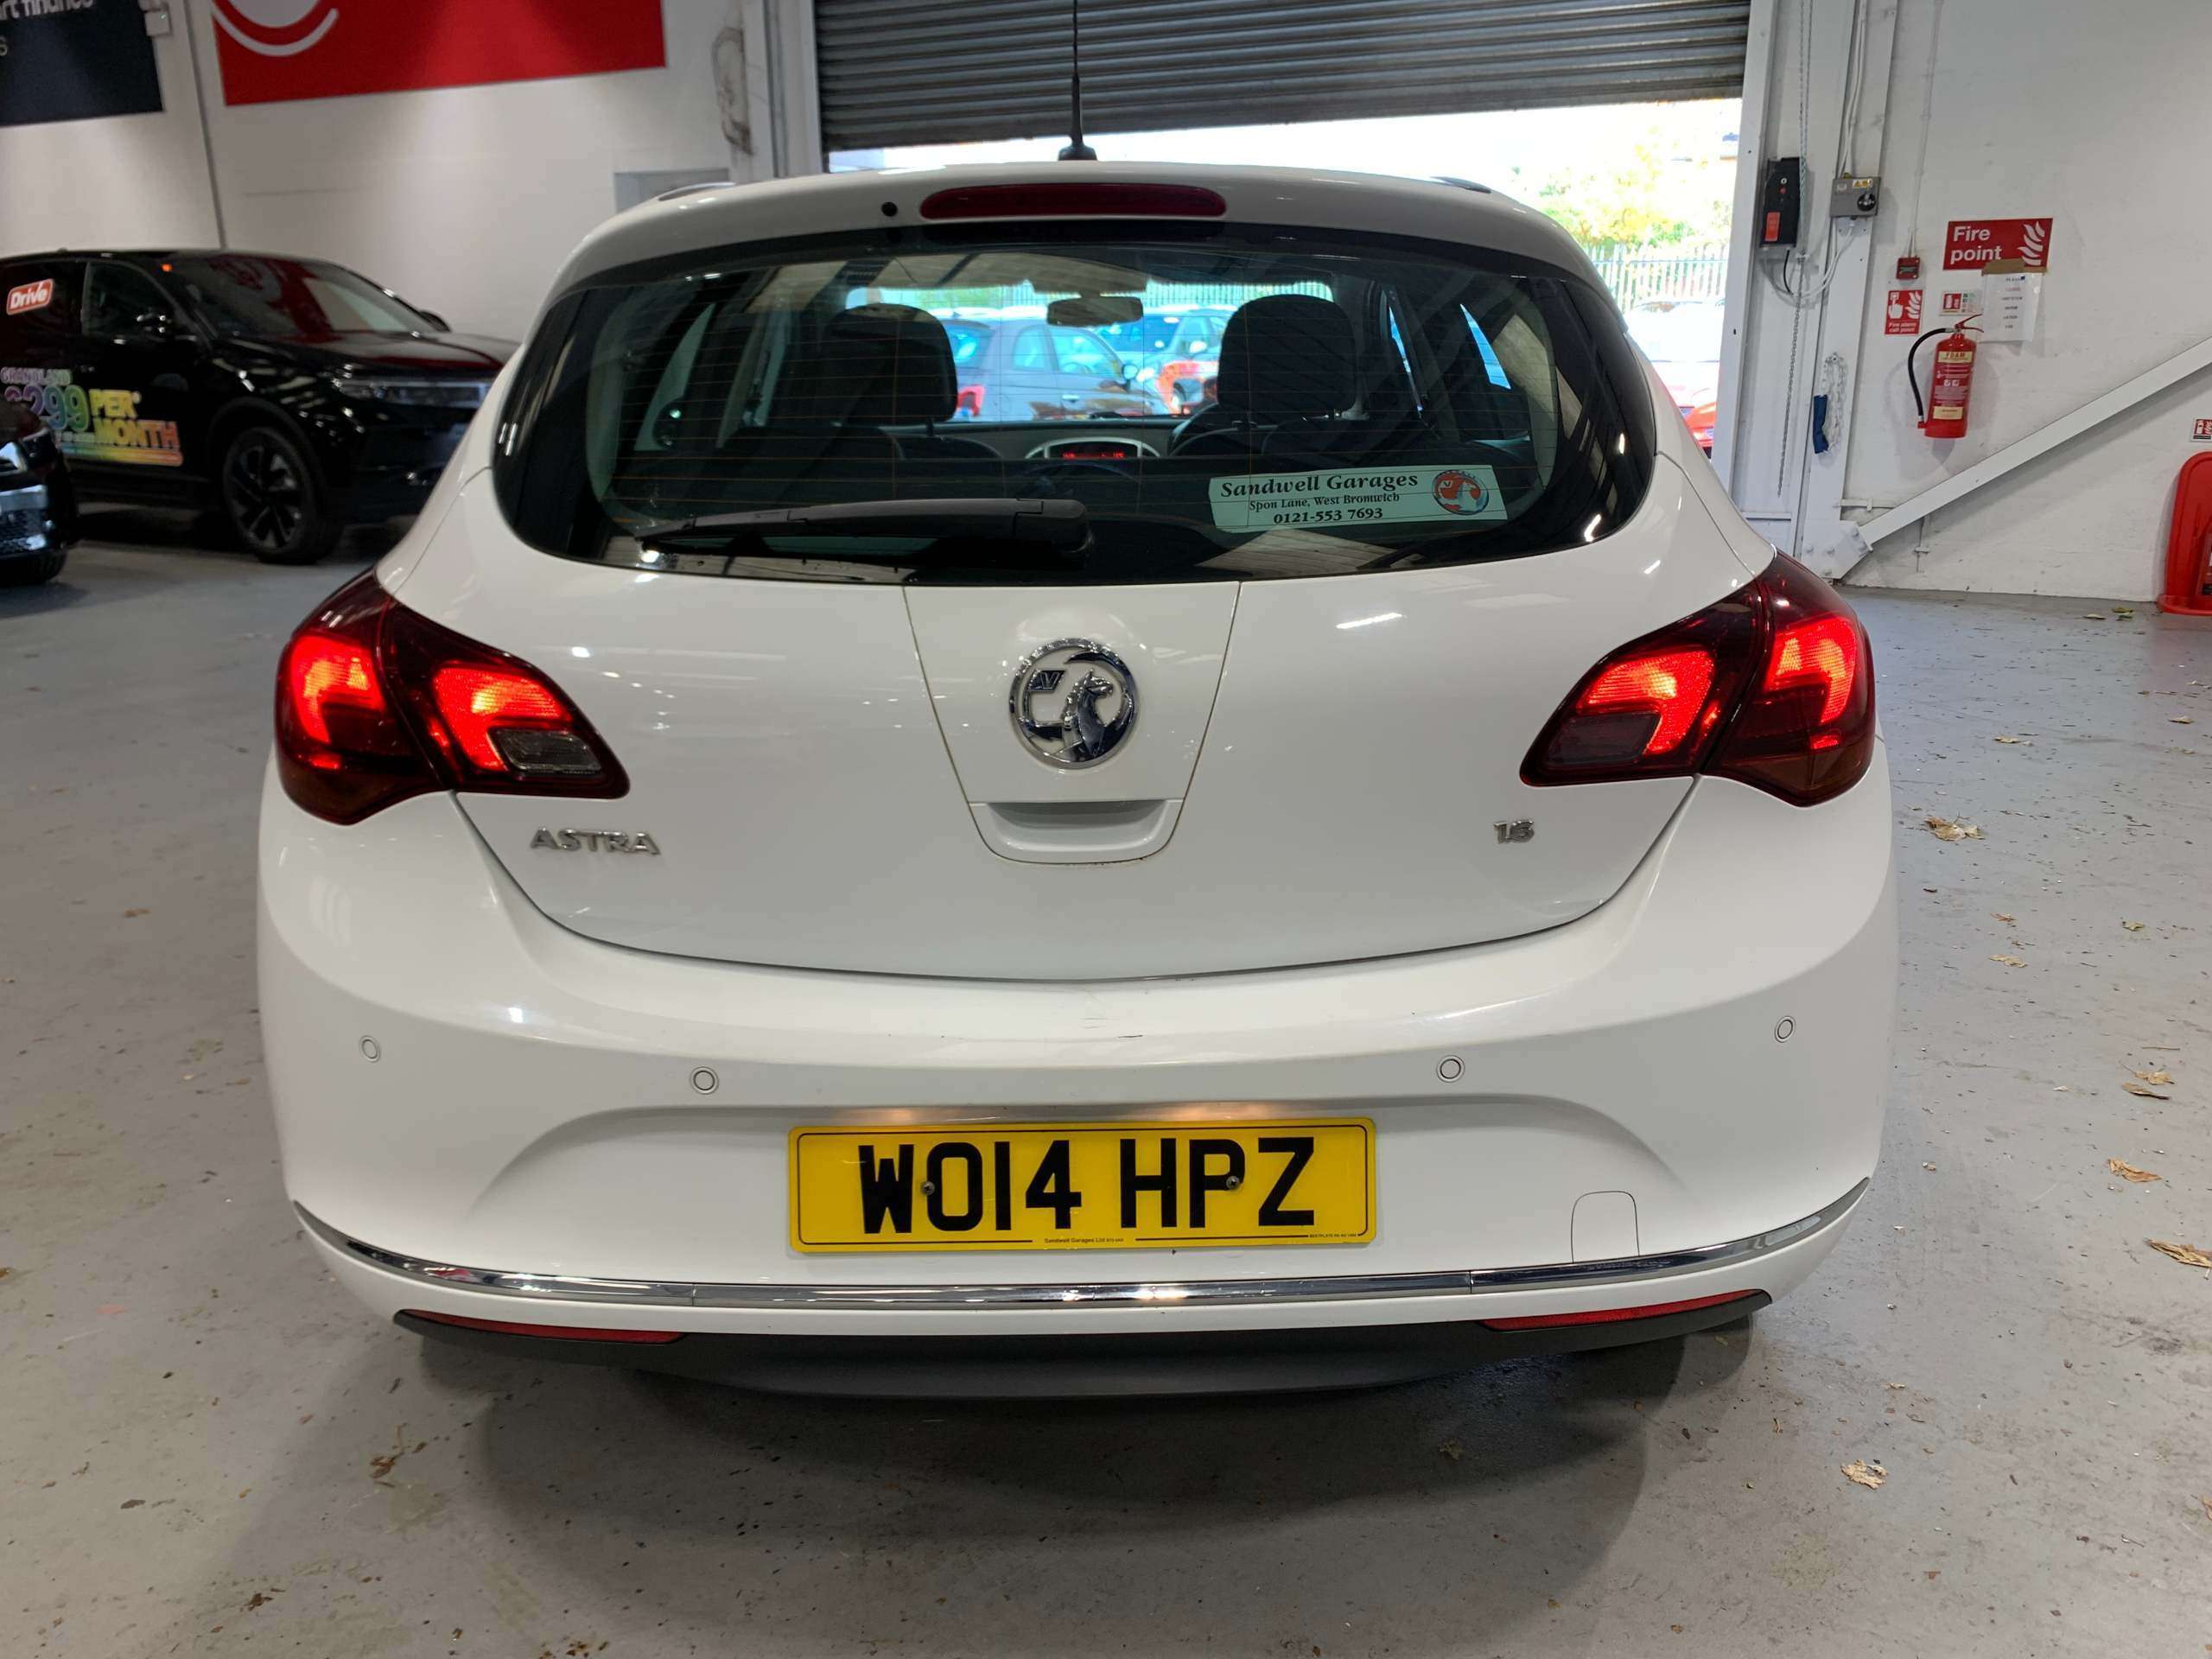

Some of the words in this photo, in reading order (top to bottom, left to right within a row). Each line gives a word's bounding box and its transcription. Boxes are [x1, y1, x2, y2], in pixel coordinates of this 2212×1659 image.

[1954, 226, 1991, 242] Fire
[1950, 245, 2002, 265] point
[10, 281, 48, 309] Drive
[92, 417, 181, 450] MONTH
[1220, 475, 1320, 498] Sandwell
[1326, 475, 1419, 492] Garages
[1249, 499, 1278, 512] Spon
[1281, 498, 1311, 508] Lane,
[1313, 496, 1340, 506] West
[1344, 492, 1401, 505] Bromwich
[1273, 510, 1343, 524] 0121-553
[1347, 507, 1383, 520] 7693
[530, 827, 661, 855] ASTRA
[857, 1139, 1083, 1234] WO14
[1119, 1136, 1315, 1229] HPZ
